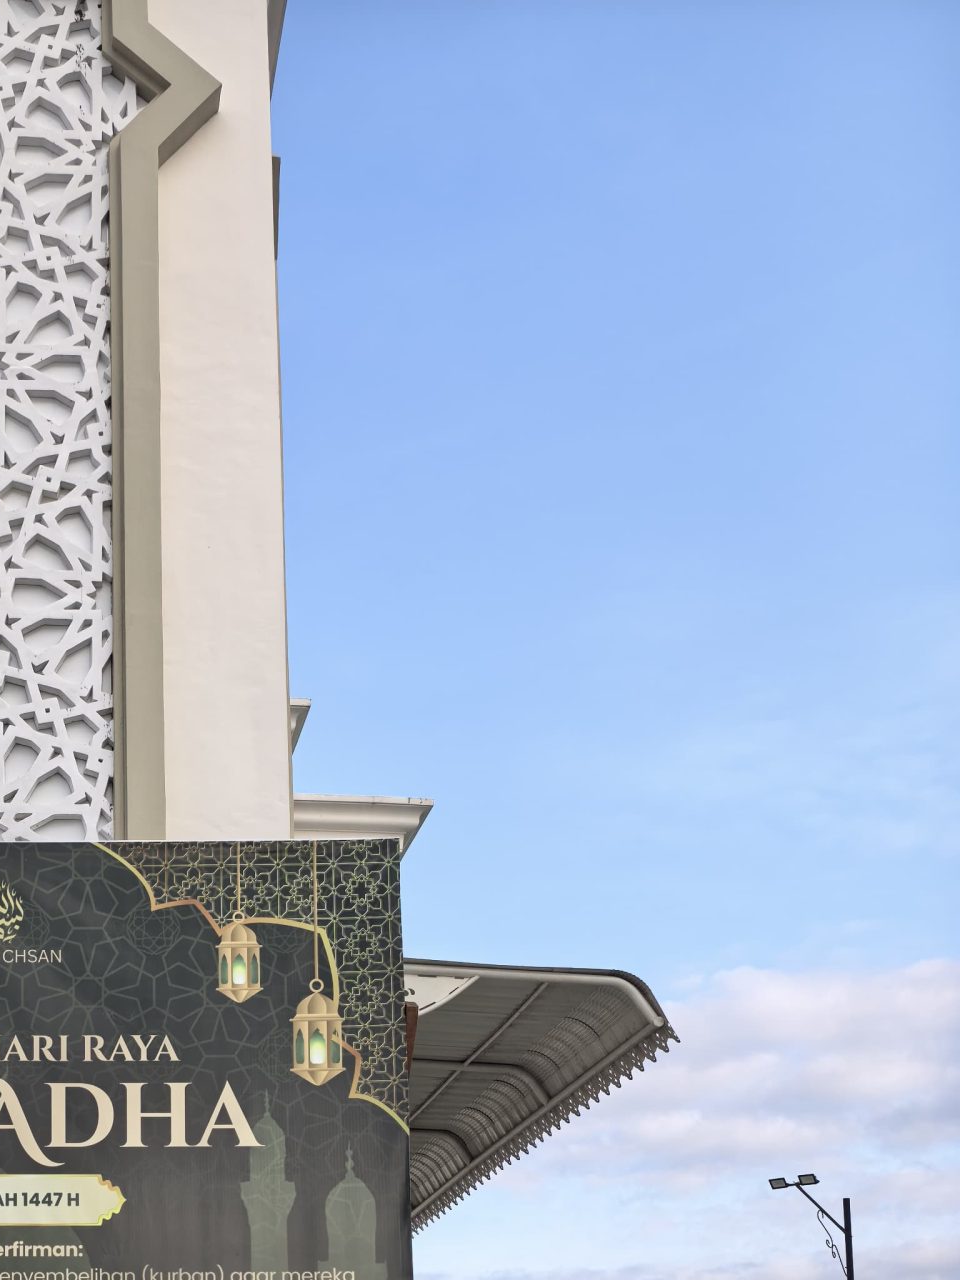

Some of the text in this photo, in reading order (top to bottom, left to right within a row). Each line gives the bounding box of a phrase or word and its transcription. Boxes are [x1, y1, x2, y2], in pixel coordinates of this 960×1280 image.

[83, 1034, 181, 1062] RAYA
[21, 1192, 63, 1207] 1447
[67, 1192, 80, 1207] H
